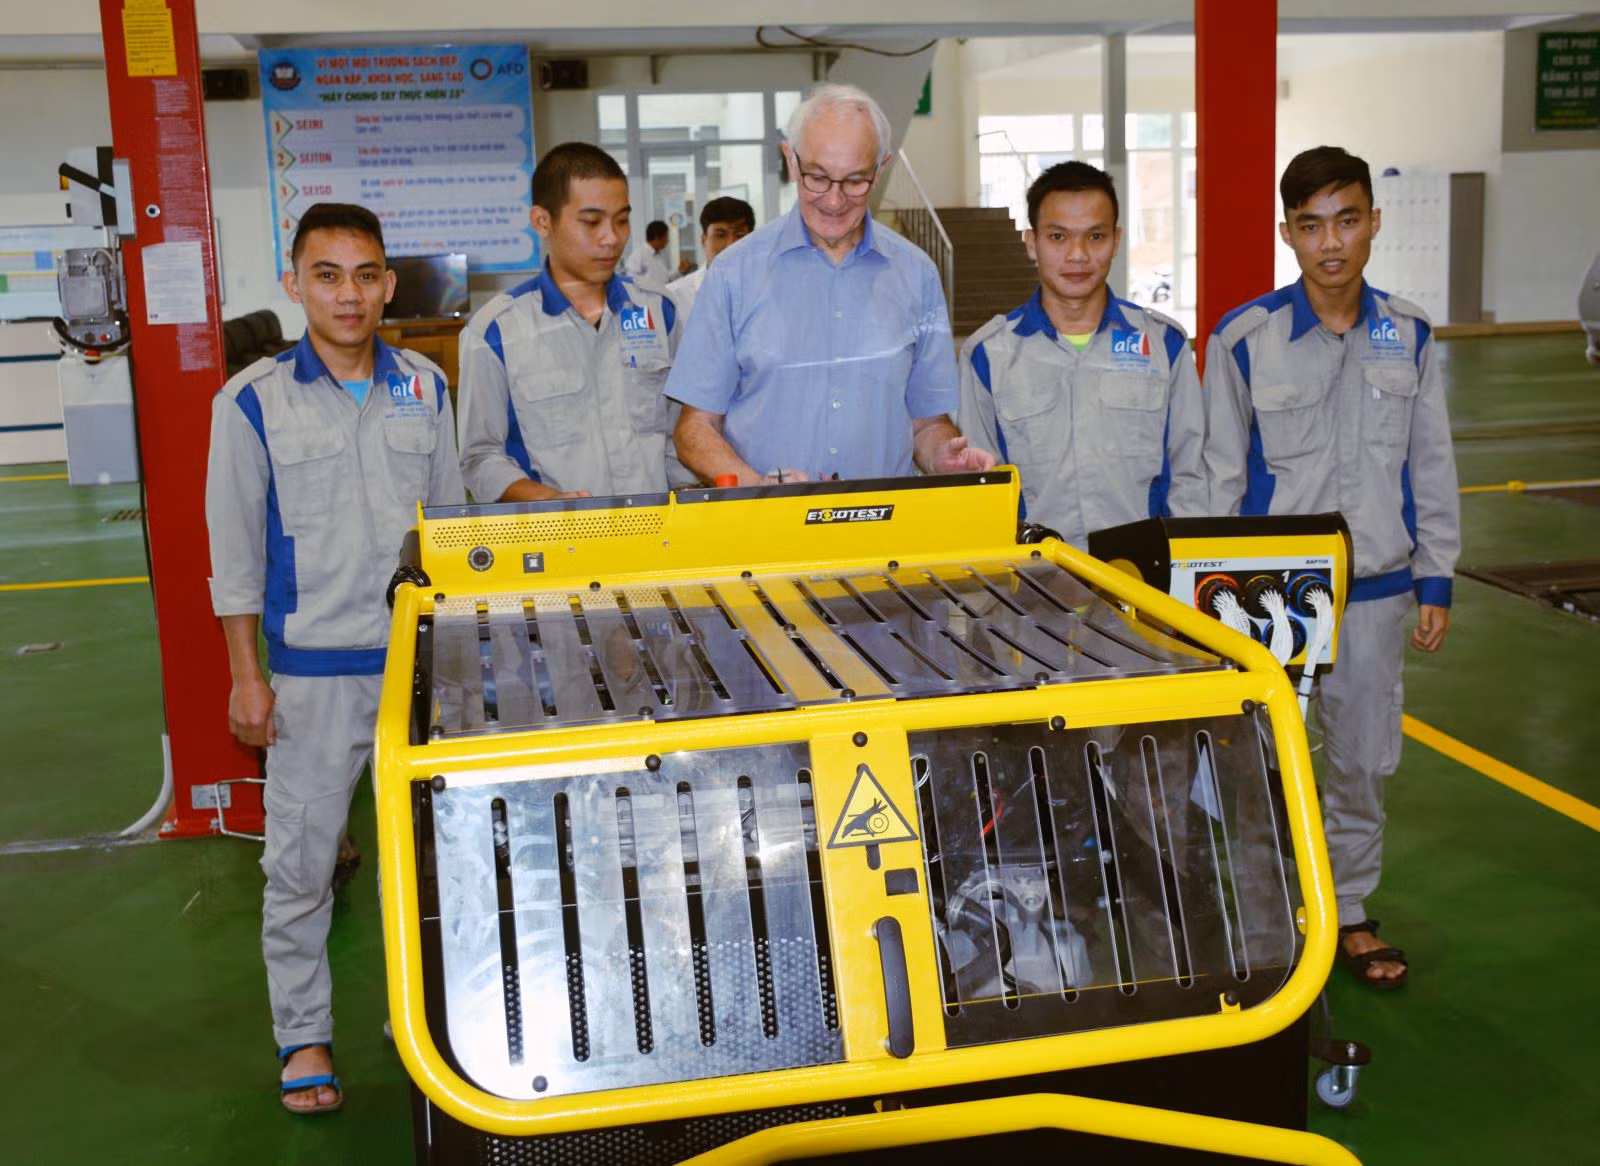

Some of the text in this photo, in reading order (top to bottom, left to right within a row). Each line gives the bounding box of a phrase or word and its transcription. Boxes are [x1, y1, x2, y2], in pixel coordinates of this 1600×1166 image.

[496, 61, 524, 75] AFD
[274, 119, 324, 134] 1 SEIRI
[276, 153, 285, 167] 2
[302, 185, 332, 197] SEISO
[282, 217, 290, 231] 4
[622, 305, 649, 331] afd
[1114, 332, 1142, 355] afd
[1282, 570, 1290, 583] 1
